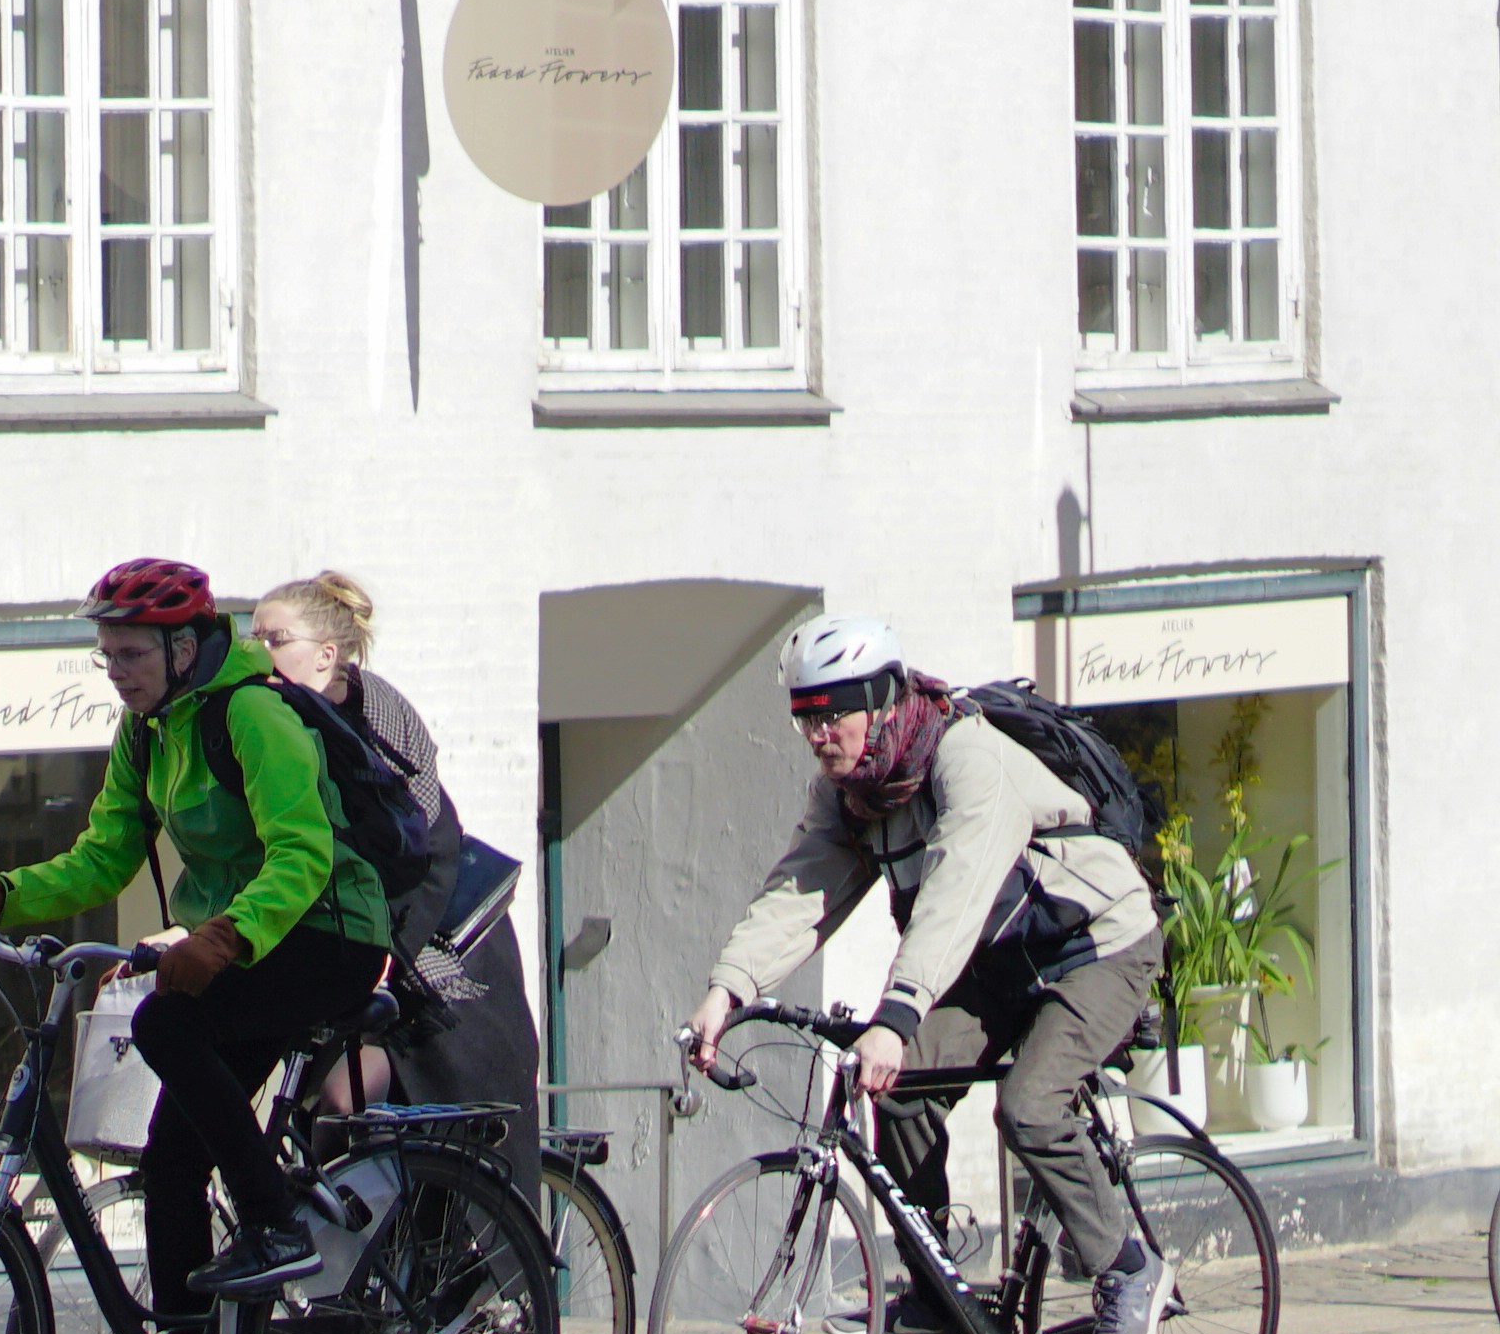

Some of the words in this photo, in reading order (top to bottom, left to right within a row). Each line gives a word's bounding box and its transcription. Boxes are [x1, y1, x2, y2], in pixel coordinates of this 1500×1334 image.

[544, 47, 575, 57] ATELIER
[467, 57, 536, 81] Faded
[539, 59, 652, 86] Flowers
[1161, 618, 1194, 633] ATELIER
[1077, 642, 1153, 687] Faded
[1156, 639, 1277, 684] Flowers
